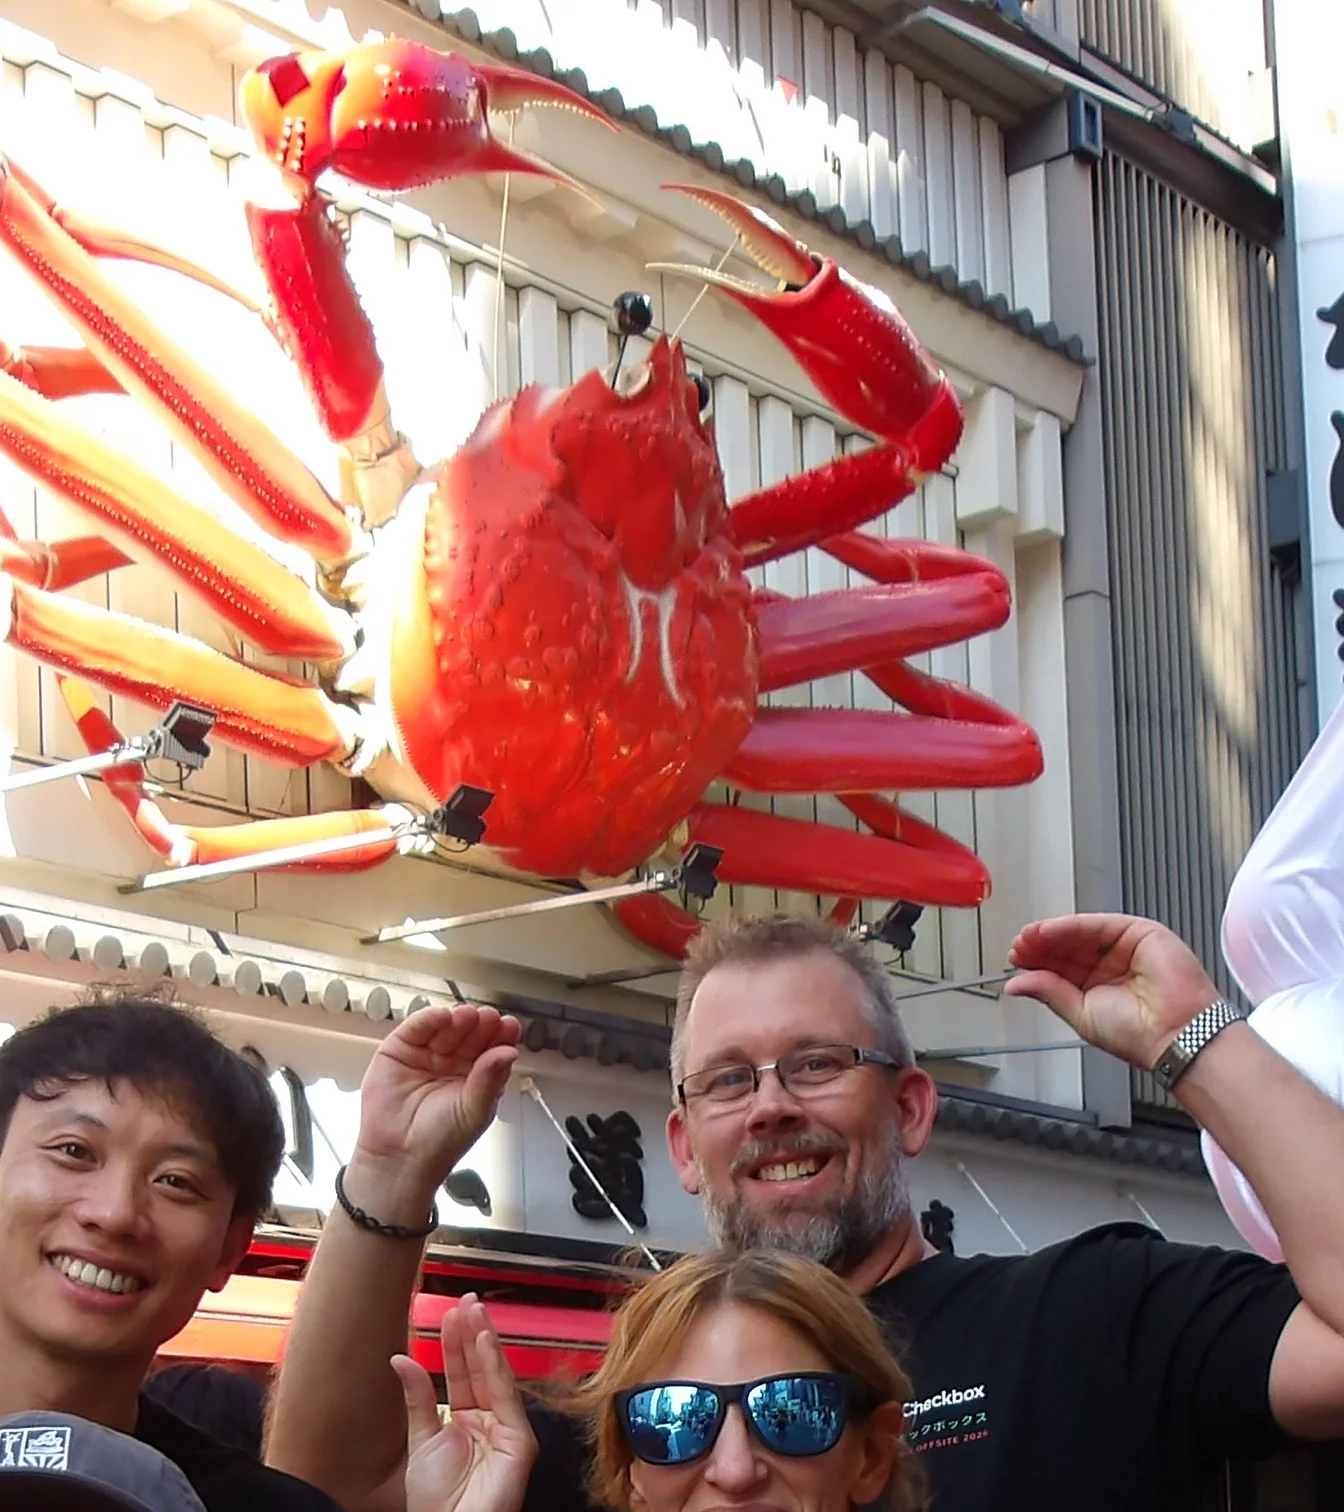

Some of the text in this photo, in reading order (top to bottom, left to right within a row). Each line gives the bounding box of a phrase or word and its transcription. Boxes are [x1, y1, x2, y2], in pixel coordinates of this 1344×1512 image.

[902, 1384, 986, 1418] Checkbox
[909, 1412, 988, 1440] ックボックス
[916, 1436, 959, 1452] OFFSITE
